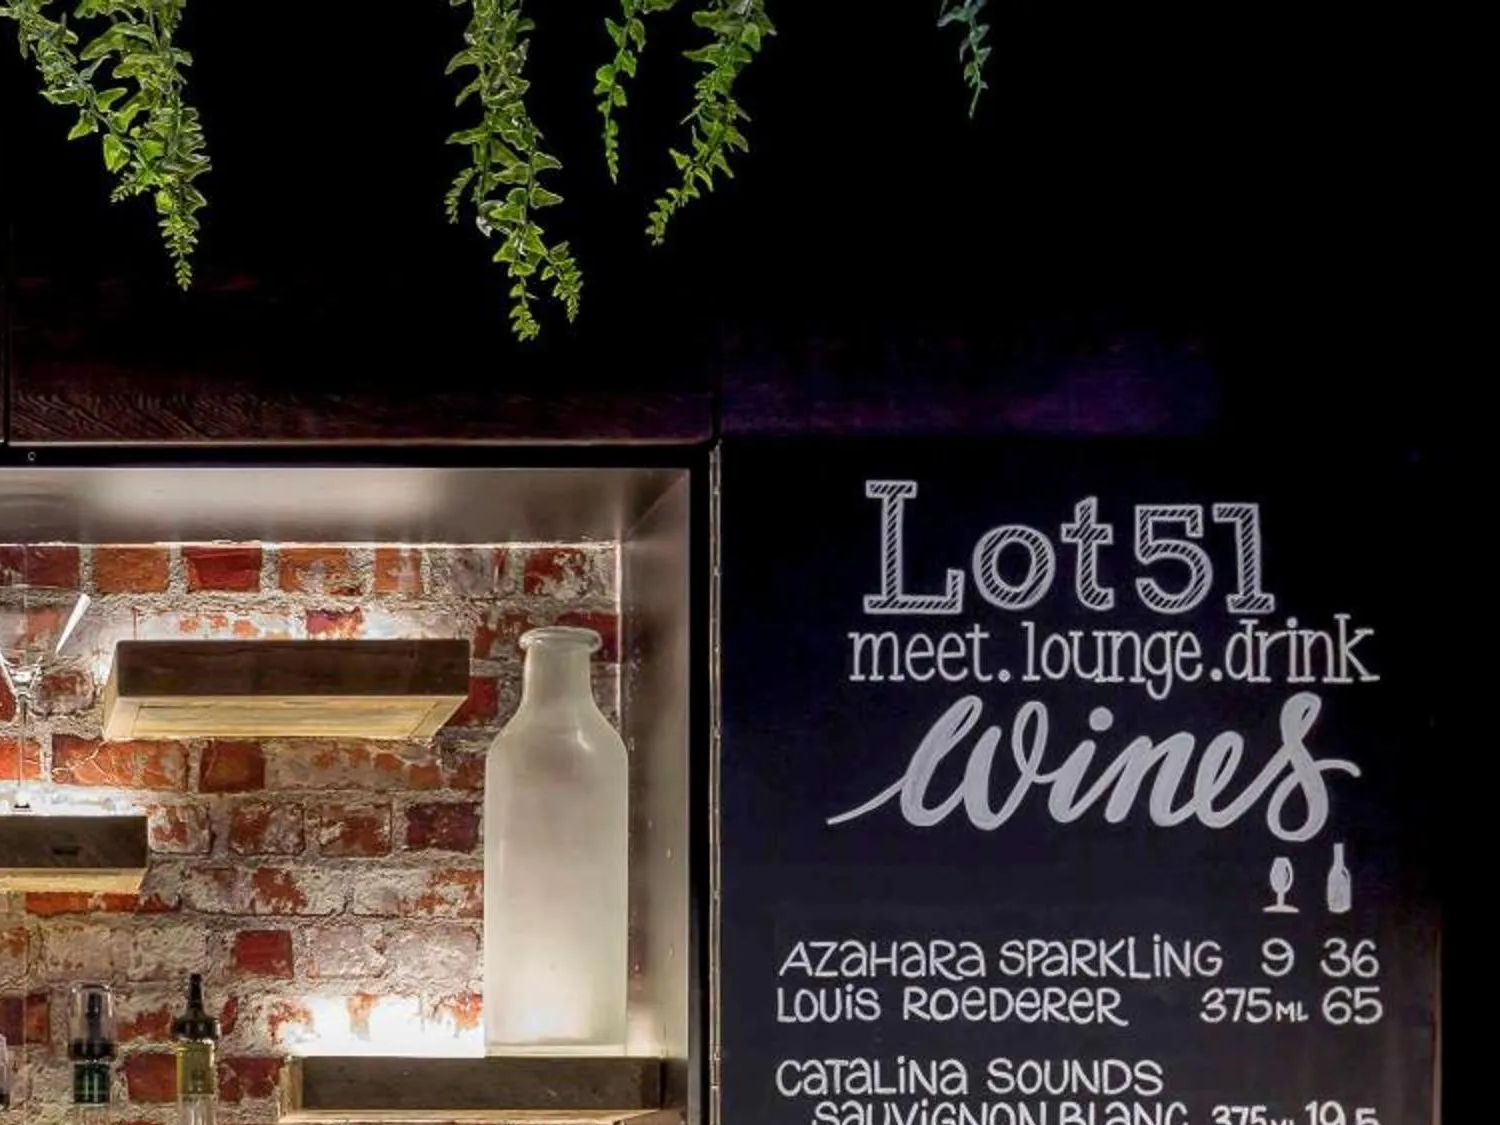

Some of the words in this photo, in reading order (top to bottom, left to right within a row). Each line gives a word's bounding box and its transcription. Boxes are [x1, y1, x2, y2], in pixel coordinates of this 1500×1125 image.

[827, 692, 1361, 841] Wines
[1262, 938, 1294, 976] 9
[1321, 938, 1378, 977] 36
[1322, 987, 1382, 1024] 65
[987, 1058, 1163, 1096] SOUNDS
